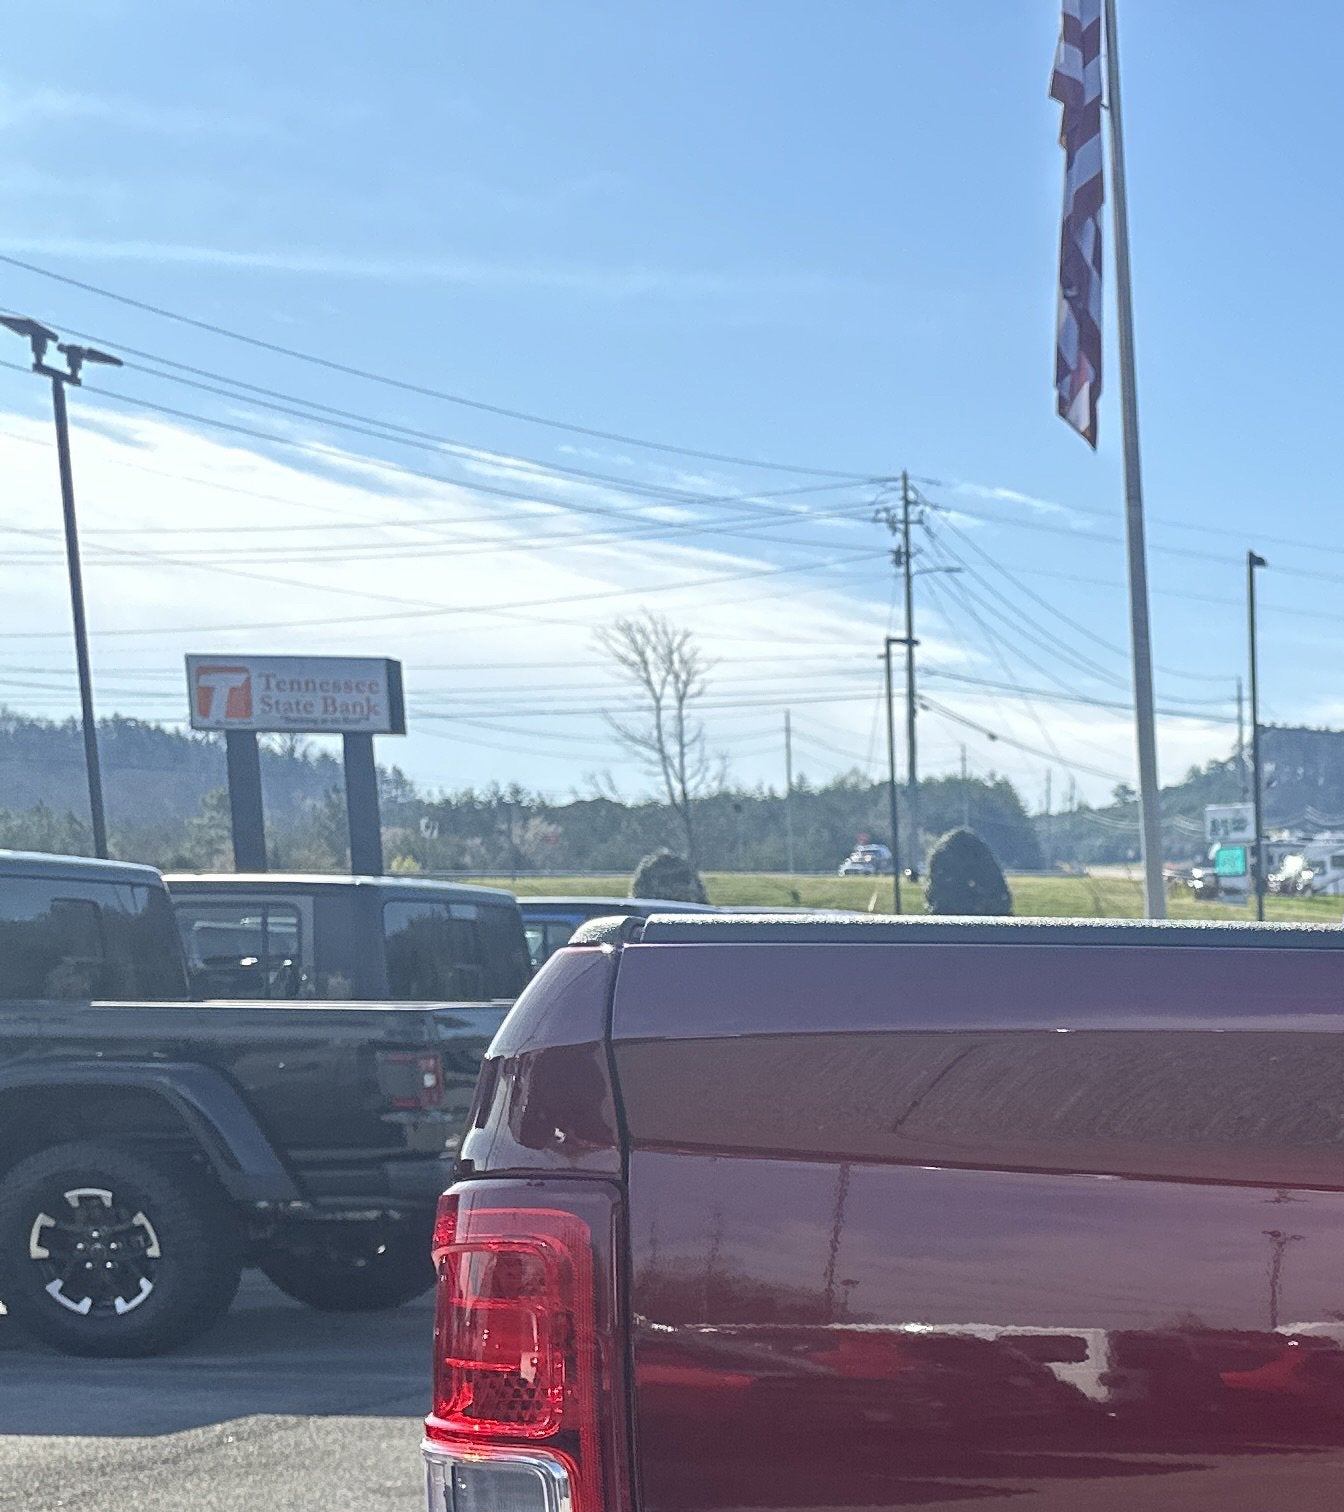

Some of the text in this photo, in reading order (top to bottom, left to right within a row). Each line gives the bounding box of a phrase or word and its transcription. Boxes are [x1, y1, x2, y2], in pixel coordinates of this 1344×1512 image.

[258, 672, 380, 695] Tennessee
[260, 695, 380, 716] State Bank
